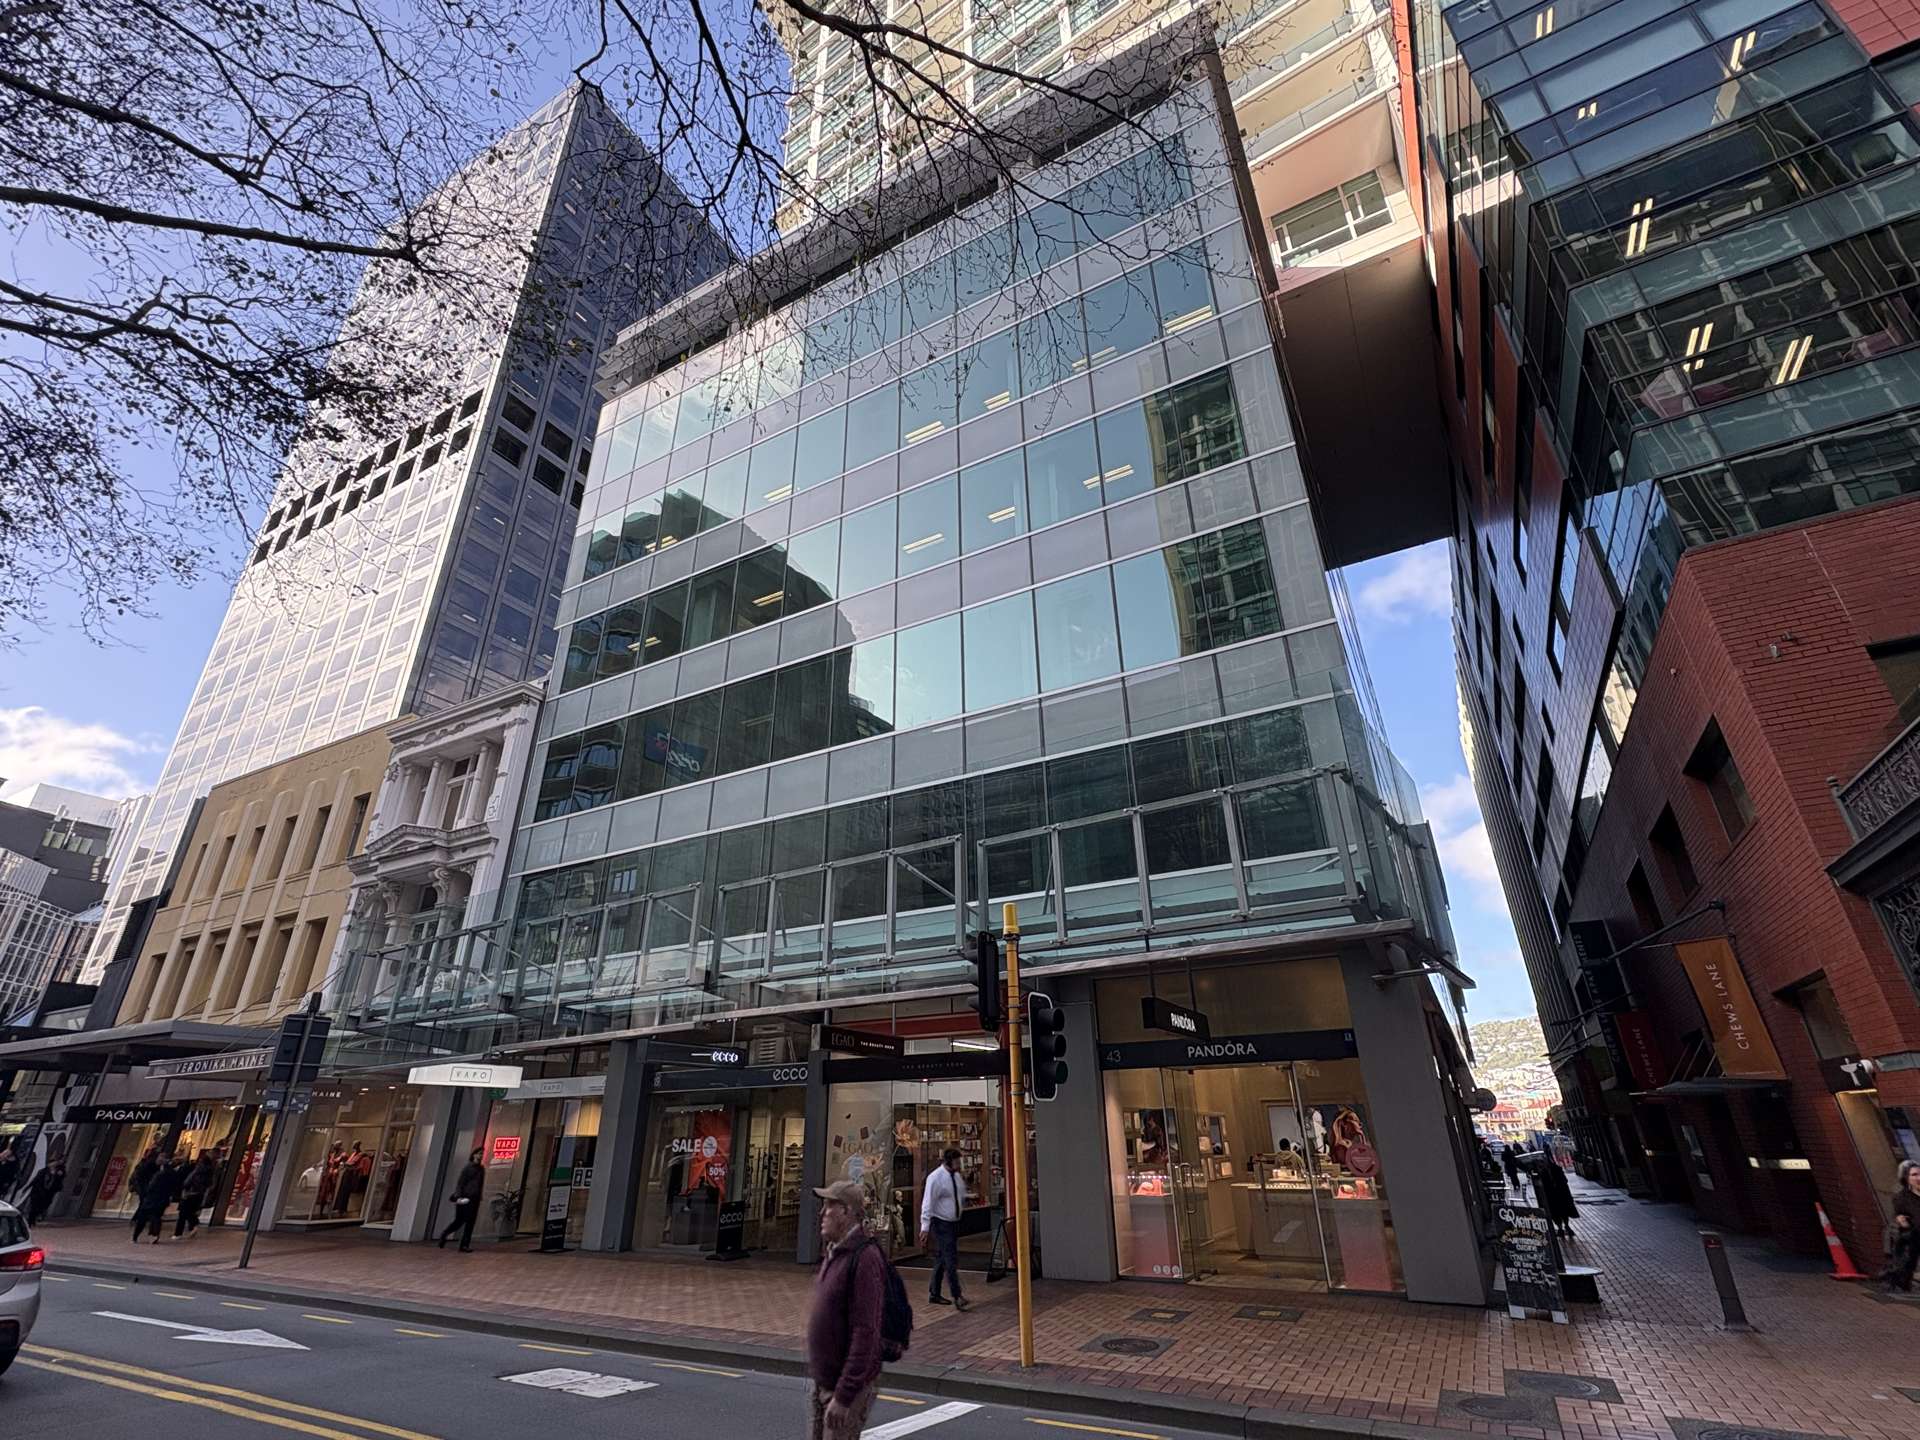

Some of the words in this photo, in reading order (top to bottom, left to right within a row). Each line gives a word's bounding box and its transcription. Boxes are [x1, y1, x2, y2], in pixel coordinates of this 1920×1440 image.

[1705, 962, 1728, 997] LANE
[1722, 1003, 1749, 1049] CHEWS
[712, 1051, 739, 1063] ecco
[1107, 1049, 1121, 1063] 43
[176, 1057, 226, 1073] VERONIKA
[227, 1054, 266, 1069] MAINE
[456, 1071, 487, 1080] VAPO
[773, 1067, 808, 1082] ecco
[95, 1110, 152, 1121] PAGANI
[496, 1140, 517, 1149] VAPO
[672, 1138, 702, 1153] SALE
[708, 1166, 726, 1177] 50%
[719, 1211, 743, 1225] ecco
